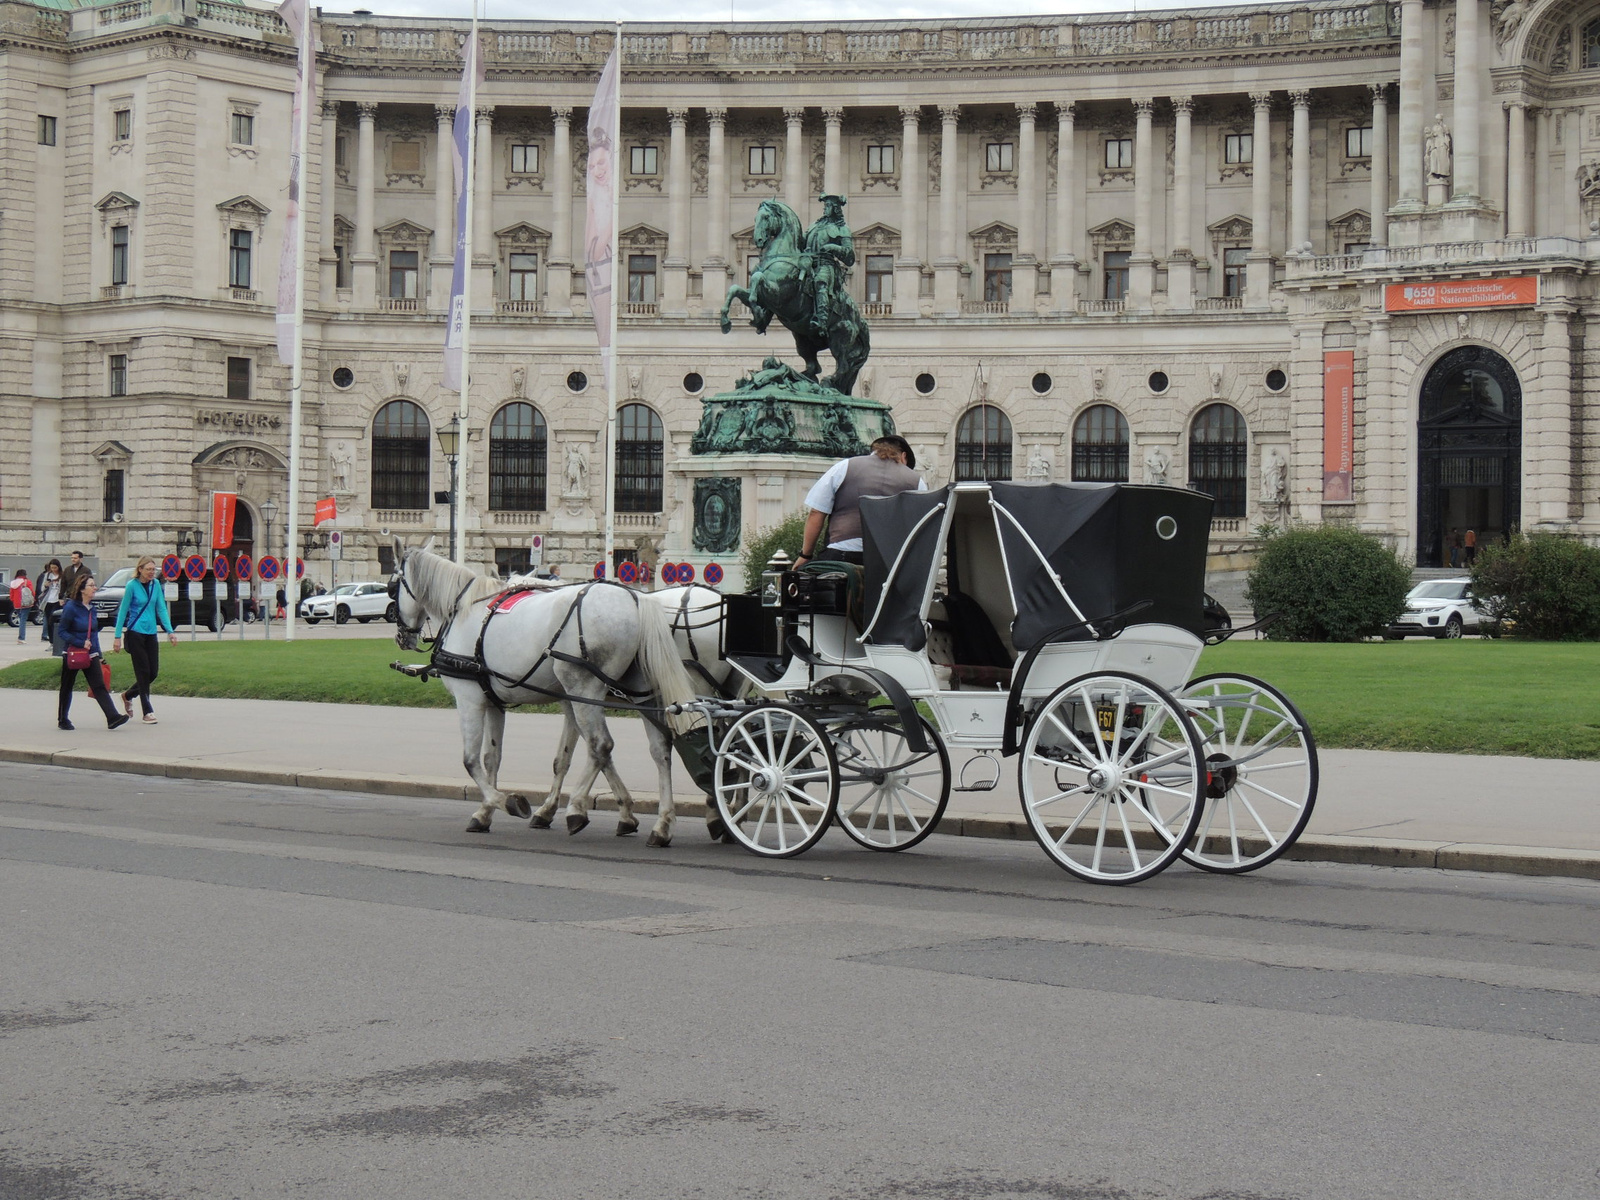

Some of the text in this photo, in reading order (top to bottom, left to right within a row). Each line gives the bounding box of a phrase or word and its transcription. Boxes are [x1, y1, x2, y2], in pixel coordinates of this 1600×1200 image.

[1413, 287, 1435, 298] 650
[1441, 284, 1503, 295] Österreichische
[1440, 292, 1517, 304] Nationalbibliothek
[196, 409, 283, 429] HOFBURG
[1339, 386, 1350, 474] Papyrusmuseum
[1098, 711, 1113, 728] F67
